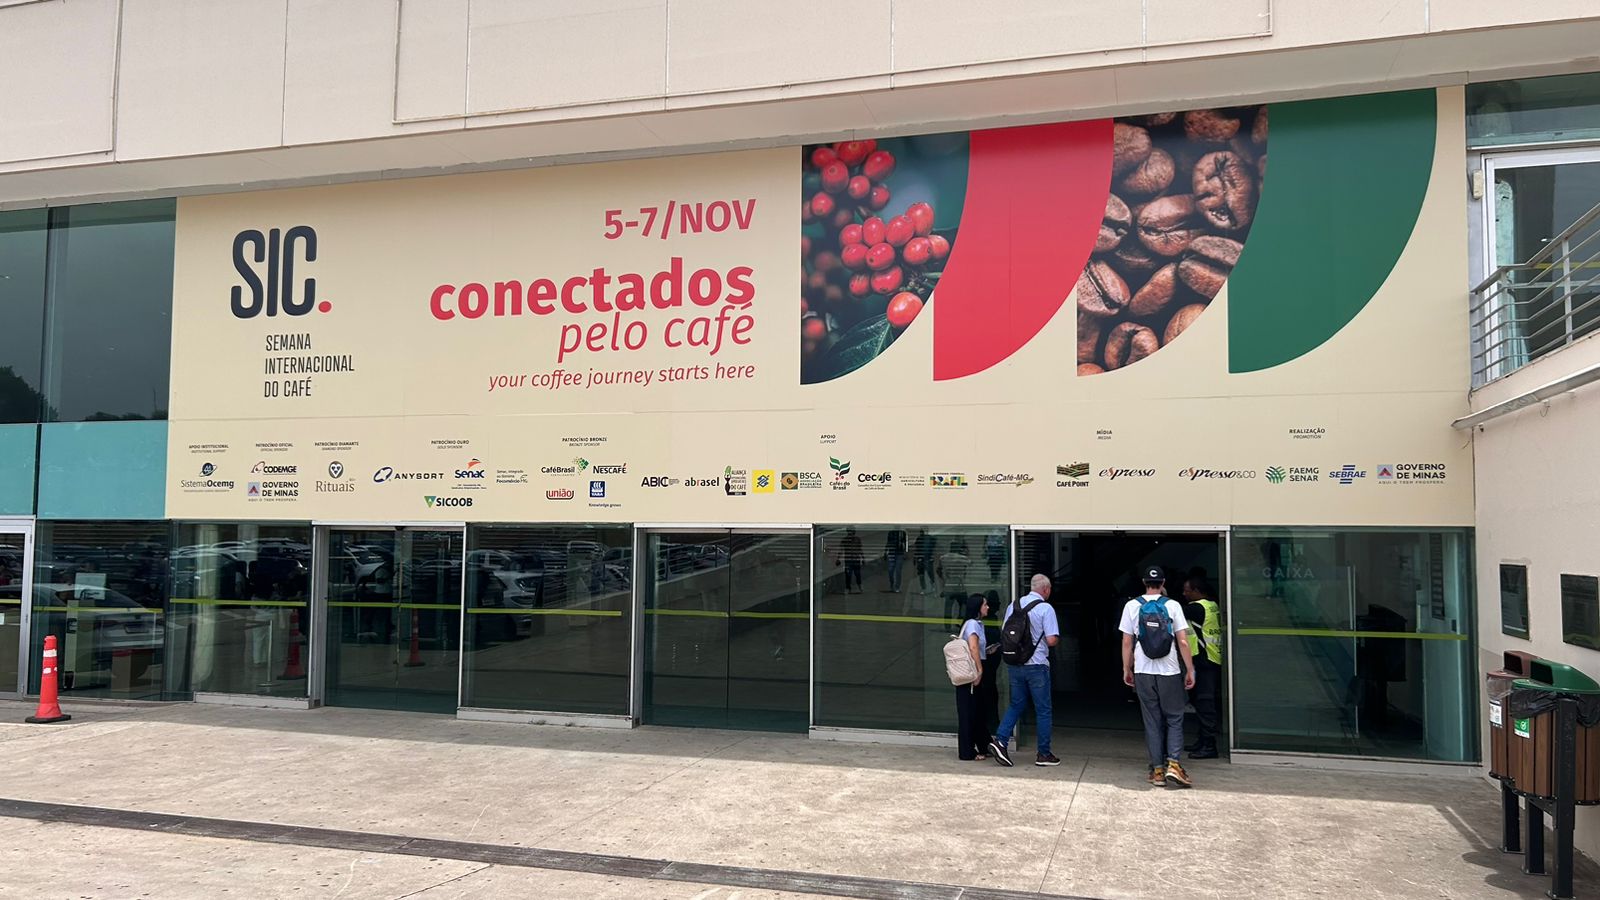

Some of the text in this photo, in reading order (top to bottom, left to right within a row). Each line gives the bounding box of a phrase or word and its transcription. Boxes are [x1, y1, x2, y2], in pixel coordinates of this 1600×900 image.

[604, 199, 756, 240] 5-7/NOV
[430, 256, 755, 320] conectados
[557, 301, 755, 363] pelo café
[265, 333, 312, 351] SEMANA
[265, 354, 355, 374] INTERNACIONAL
[488, 362, 755, 392] your coffee journey starts here
[264, 376, 312, 398] DO CAFÉ
[263, 465, 297, 474] CODEMGE
[541, 466, 575, 474] CaféBrasil
[593, 463, 627, 474] NESCAFÉ
[1396, 463, 1446, 471] GOVERNO
[394, 472, 444, 480] ANYSORT
[455, 469, 485, 479] Senac
[977, 473, 1029, 483] SindiCafé-MG
[1098, 466, 1156, 480] espresso
[1328, 470, 1367, 478] SEBRAE
[1396, 472, 1446, 480] DE MINAS
[315, 480, 355, 493] Rituais
[641, 476, 669, 487] ABIC
[684, 477, 720, 487] abrasel
[548, 488, 572, 498] união
[436, 497, 473, 507] SICOOB
[1262, 567, 1315, 578] CAIXA
